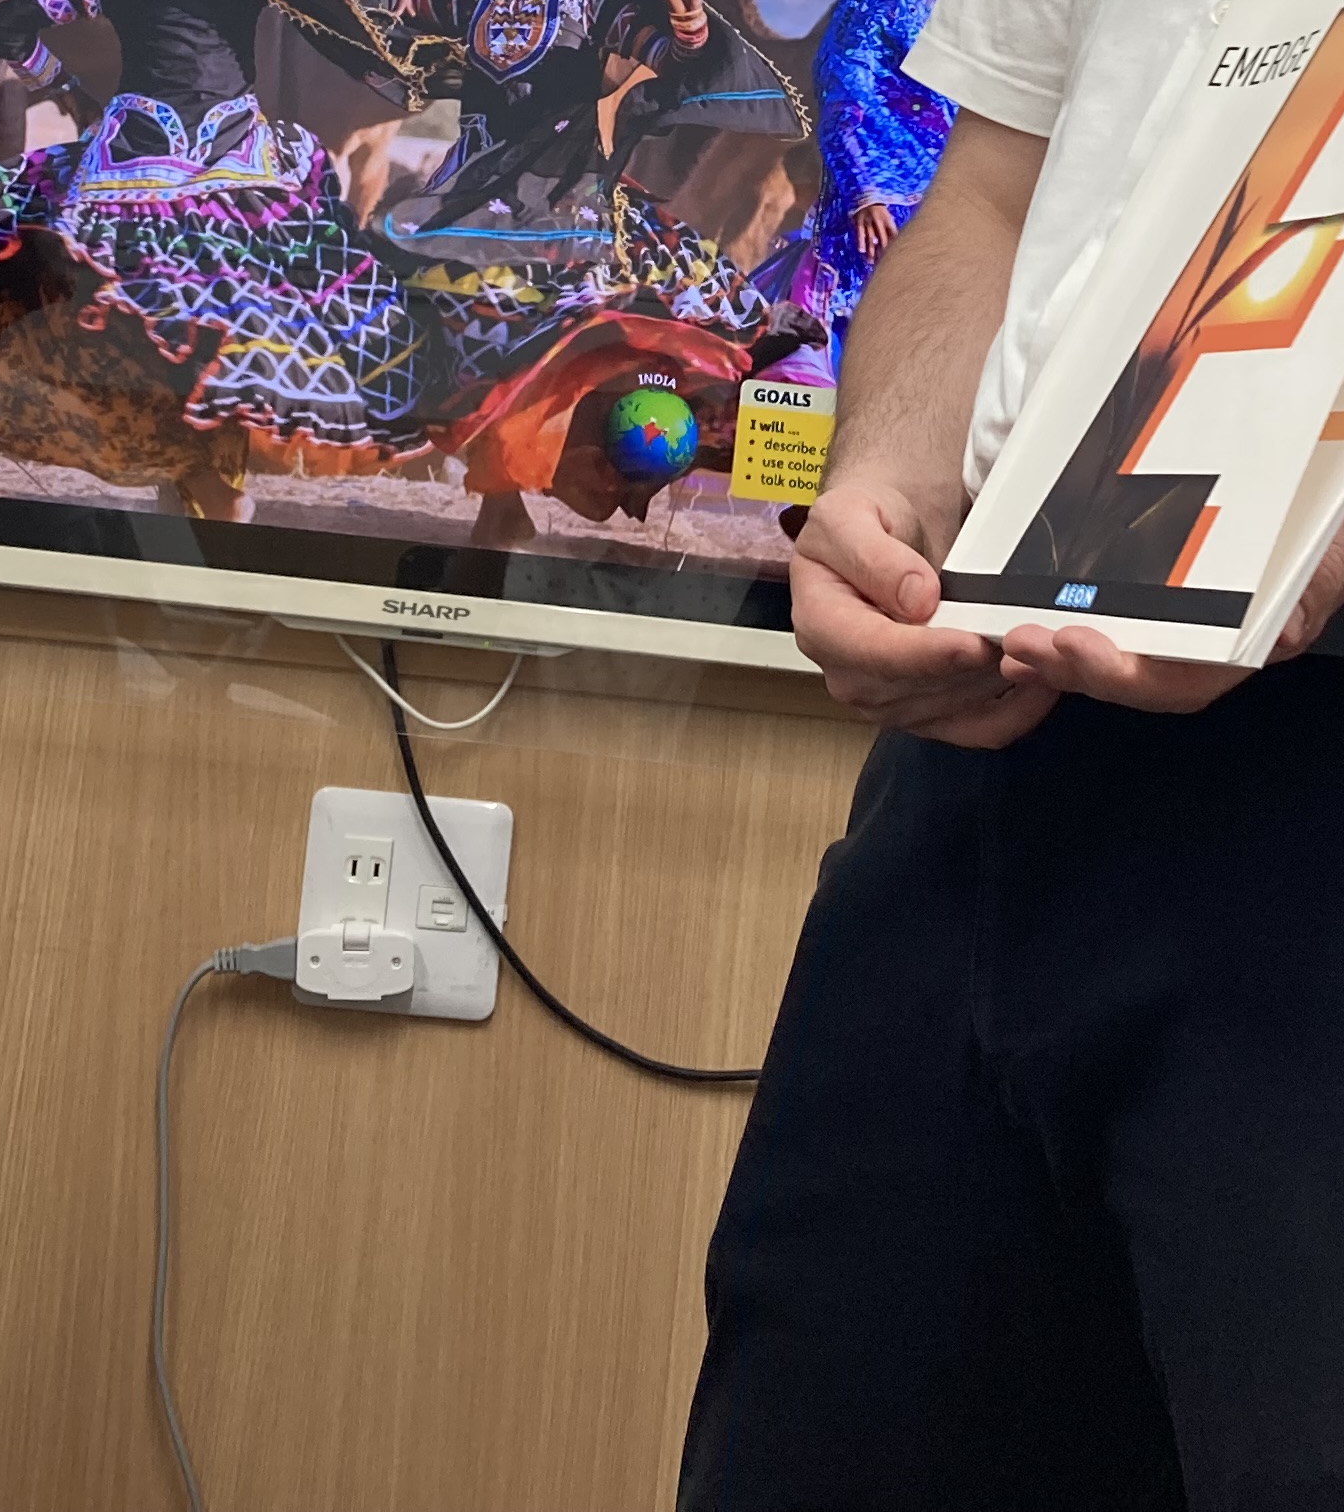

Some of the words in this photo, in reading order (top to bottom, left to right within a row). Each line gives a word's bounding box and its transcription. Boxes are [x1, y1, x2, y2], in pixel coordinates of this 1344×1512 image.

[1208, 29, 1321, 89] EMERGE
[638, 372, 677, 390] INDIA
[754, 388, 812, 407] GOALS
[750, 419, 757, 430] I
[759, 420, 785, 433] will
[764, 438, 817, 456] describe
[762, 458, 784, 469] use
[760, 473, 785, 487] talk
[1056, 583, 1099, 610] AEON
[381, 598, 471, 621] SHARP
